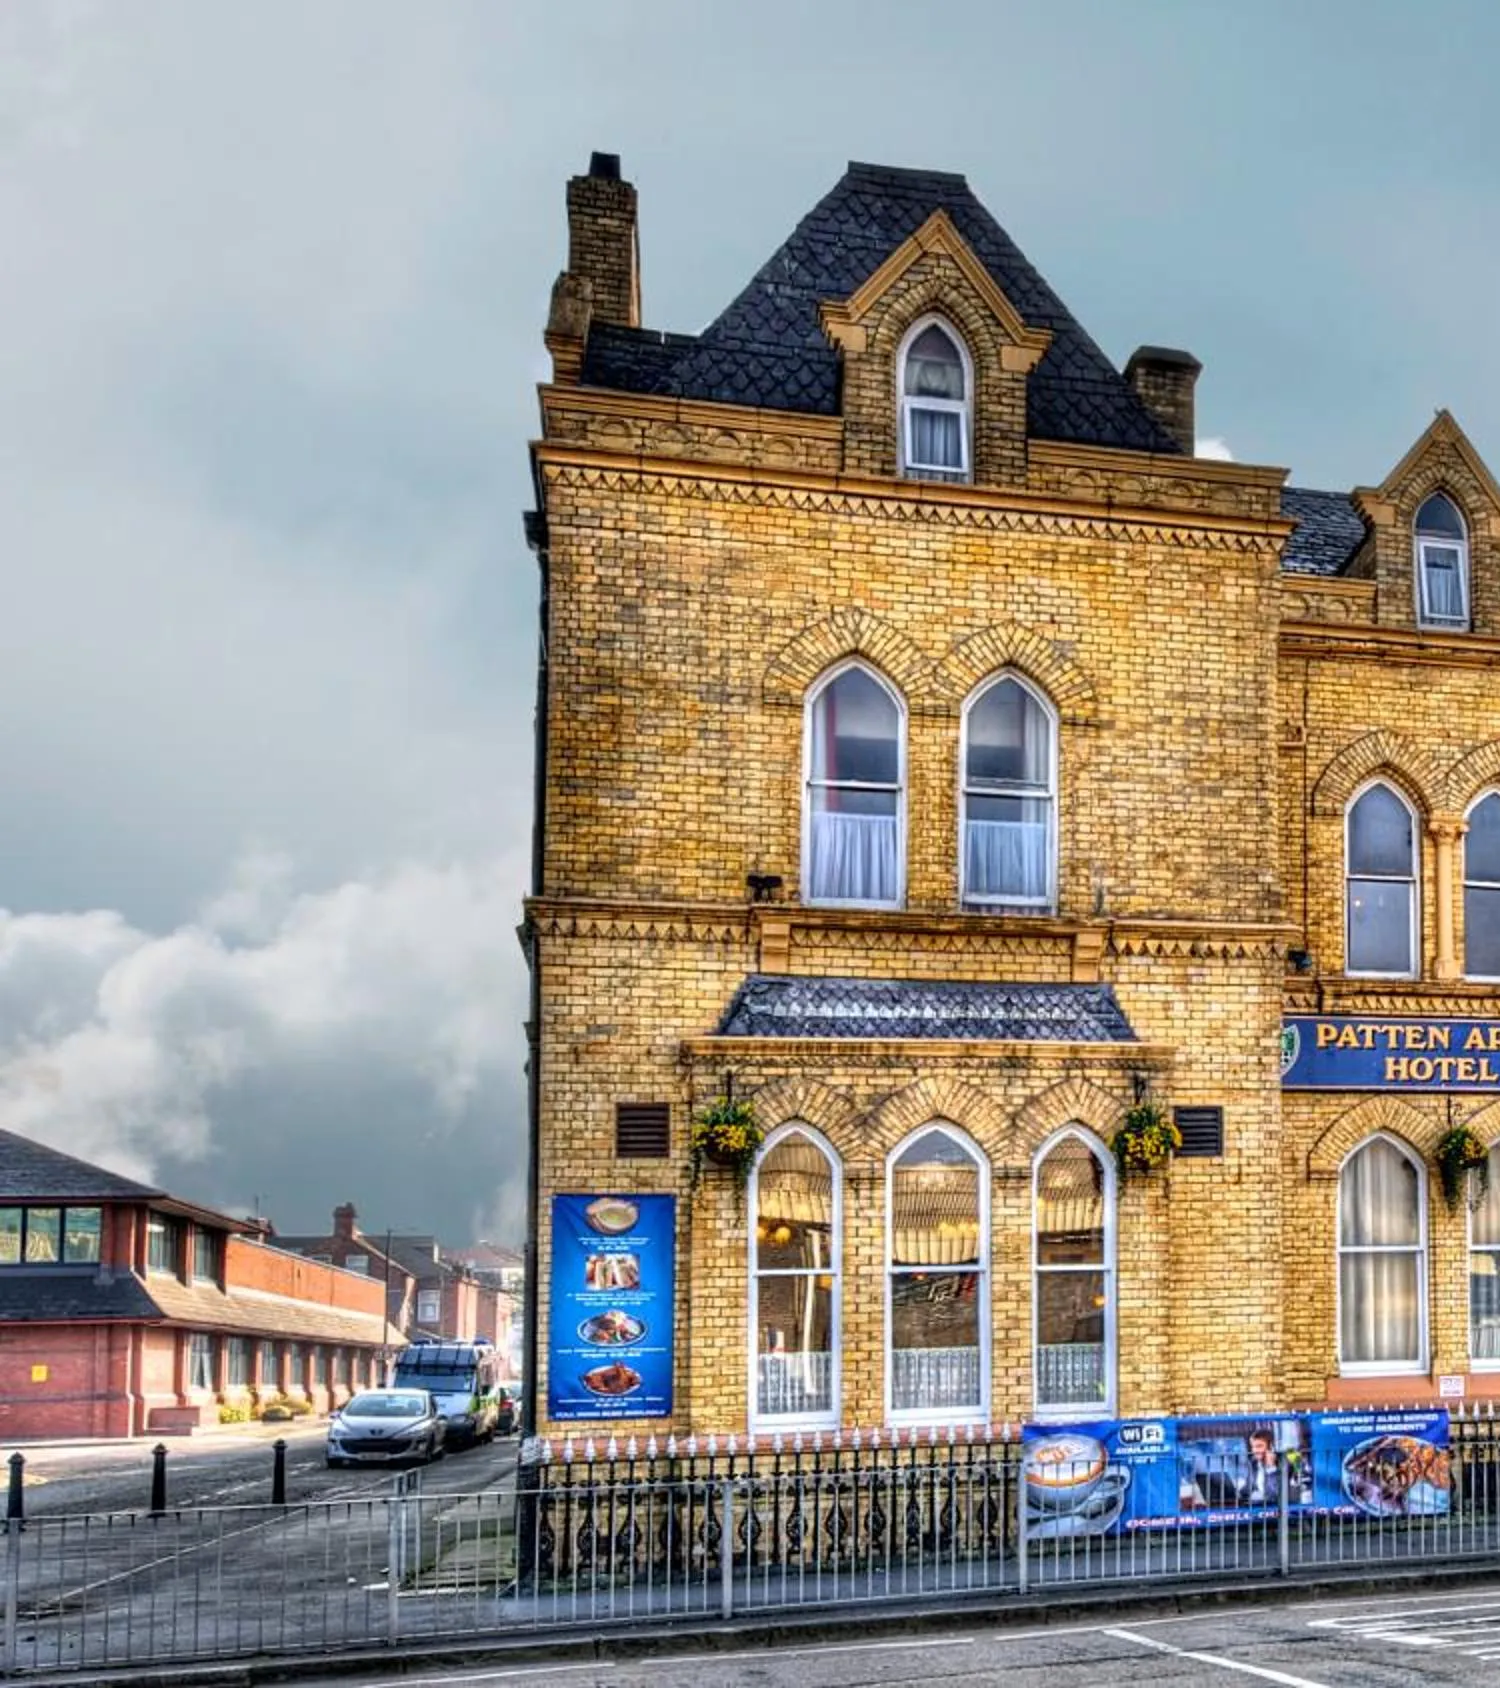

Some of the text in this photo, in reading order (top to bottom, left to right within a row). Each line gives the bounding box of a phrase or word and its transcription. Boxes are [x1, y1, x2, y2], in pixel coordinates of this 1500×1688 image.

[1317, 1024, 1450, 1050] PATTEN
[1384, 1057, 1499, 1081] HOTEL
[1321, 1415, 1375, 1425] BREAKFAST
